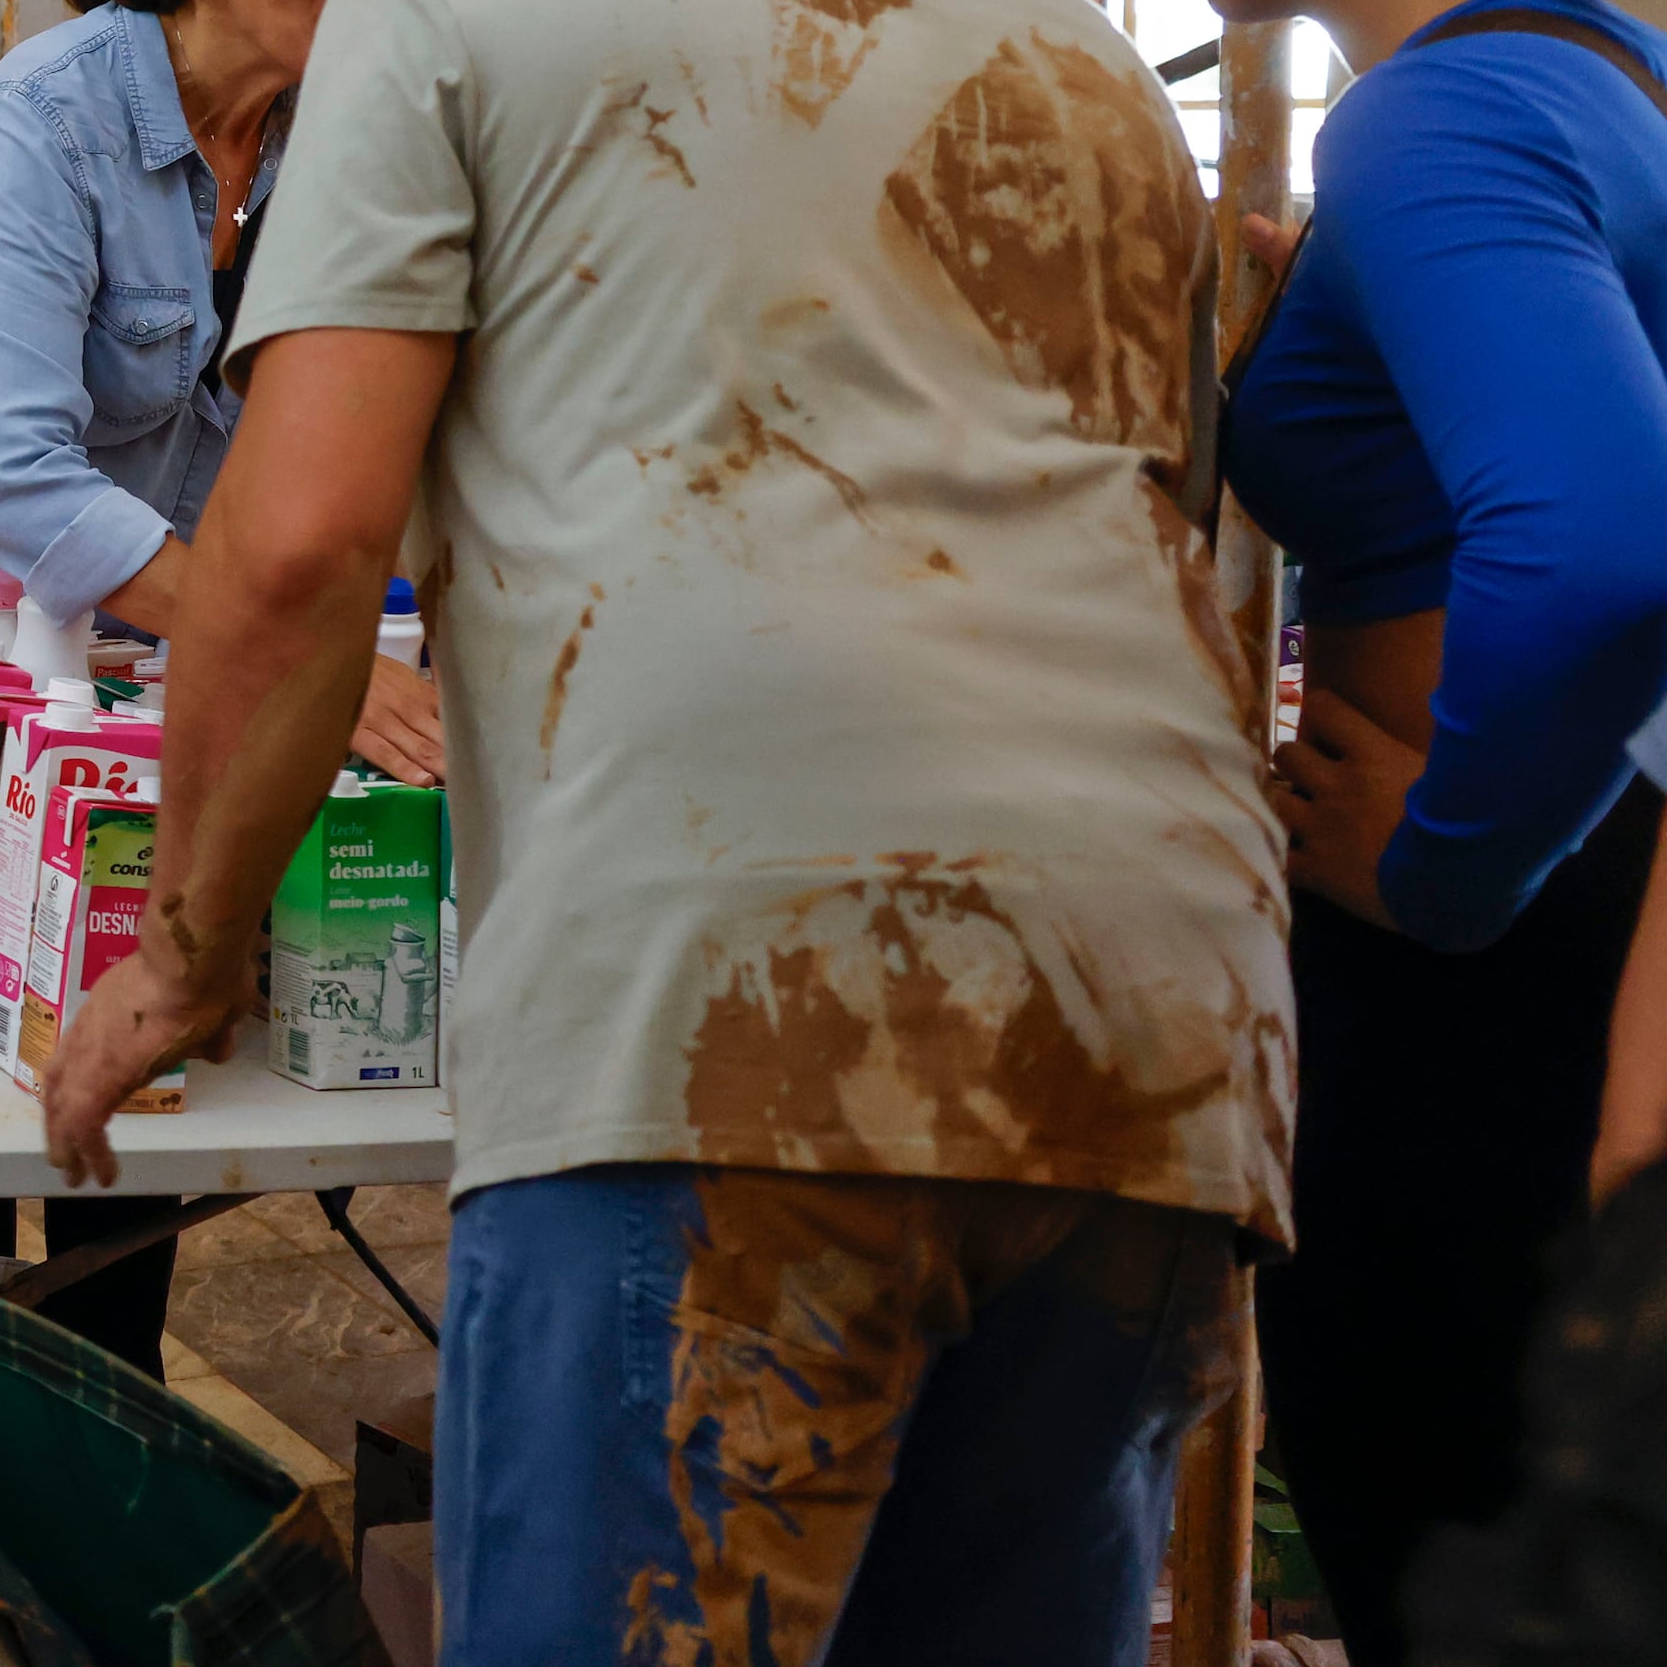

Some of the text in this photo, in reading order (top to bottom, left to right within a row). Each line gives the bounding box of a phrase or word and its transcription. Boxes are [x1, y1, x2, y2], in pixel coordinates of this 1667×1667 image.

[5, 774, 35, 820] Río
[329, 839, 374, 858] semi
[329, 860, 430, 880] desnatada
[89, 911, 139, 936] DESN
